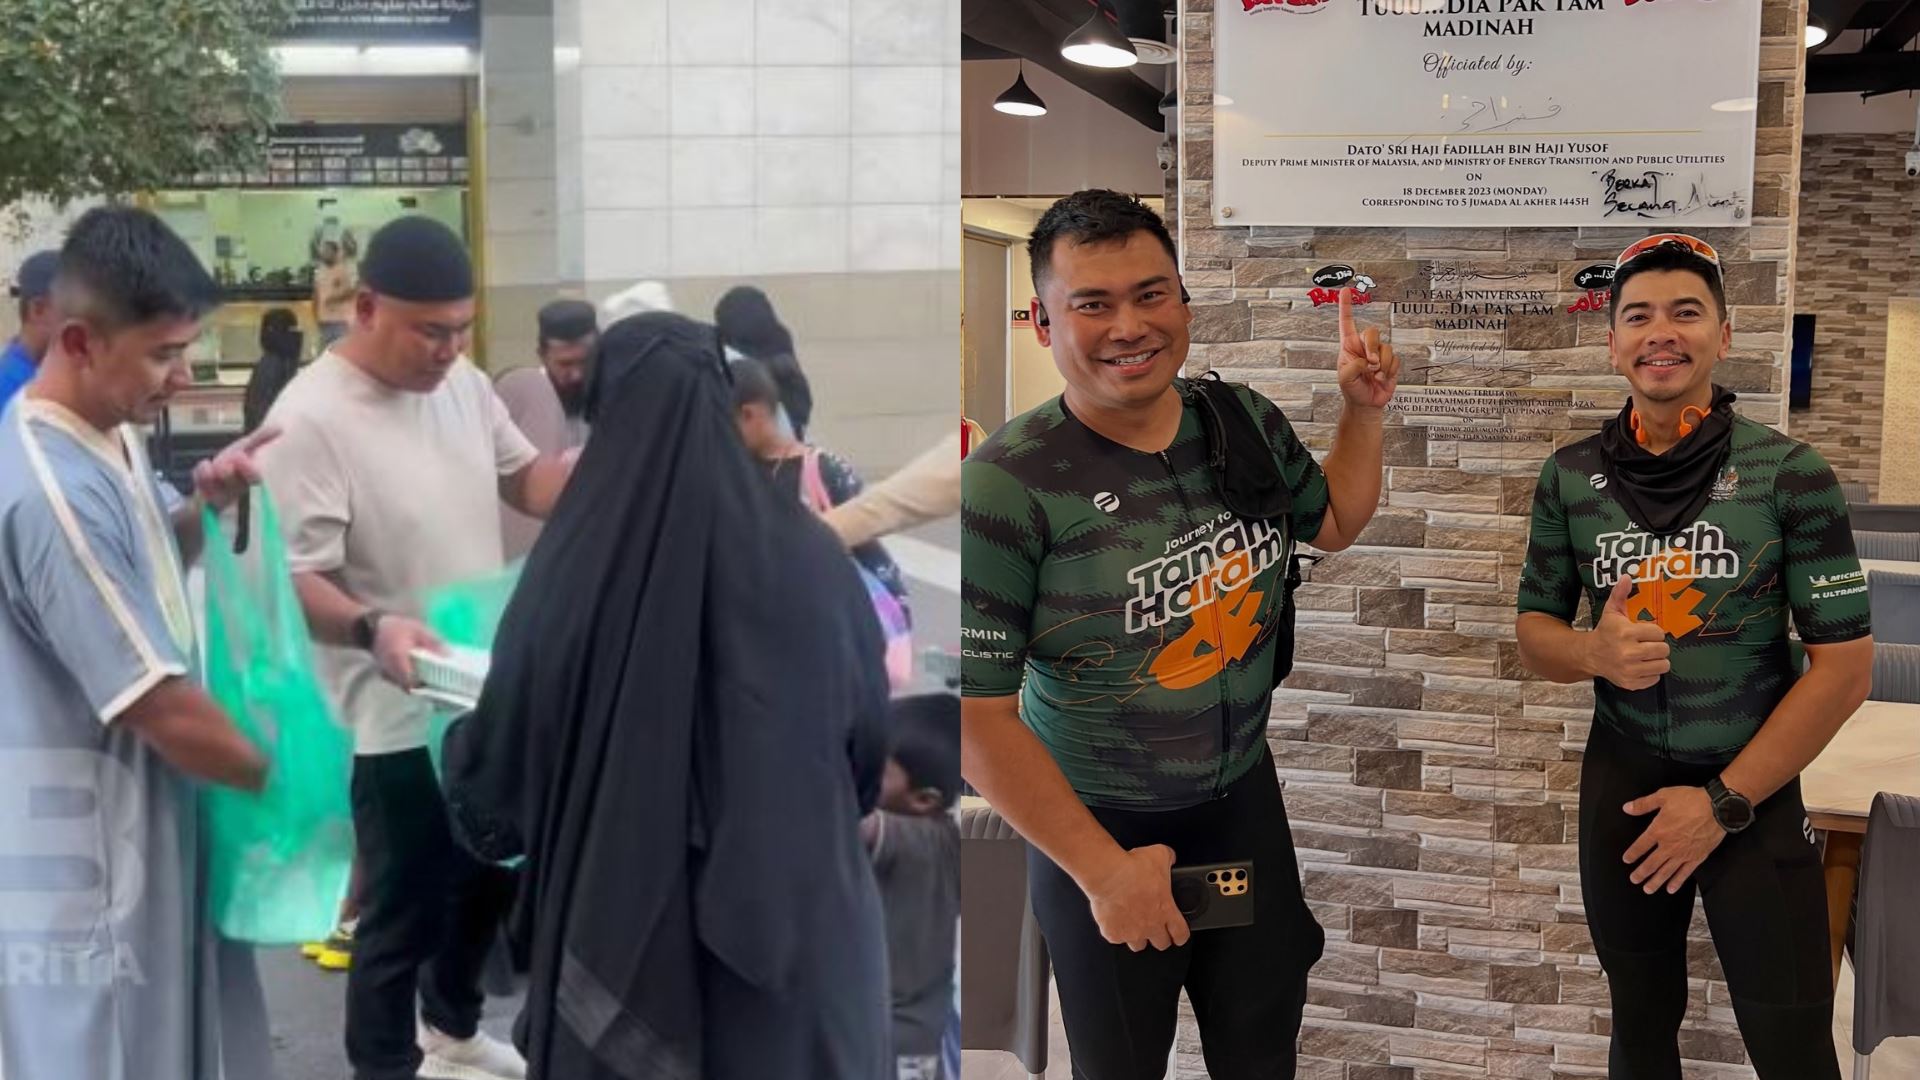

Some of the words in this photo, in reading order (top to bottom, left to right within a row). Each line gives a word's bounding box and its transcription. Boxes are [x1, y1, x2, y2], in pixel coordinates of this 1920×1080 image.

[1423, 18, 1534, 37] MADINAH
[1423, 52, 1501, 78] Officiated
[1506, 54, 1529, 77] by:
[1388, 144, 1408, 155] SRI
[1411, 144, 1439, 157] HAJI
[1443, 143, 1504, 155] FADILLAH
[1509, 143, 1531, 154] BIN
[1535, 142, 1564, 155] HAJI
[1566, 142, 1609, 153] YUSOF
[1242, 158, 1277, 167] DEPUTY
[1280, 158, 1308, 167] PRIME
[1310, 158, 1355, 167] MINISTER
[1357, 158, 1370, 167] OF
[1371, 158, 1419, 168] MALAYSIA,
[1421, 158, 1442, 166] AND
[1444, 157, 1491, 166] MINISTRY
[1493, 157, 1507, 166] OF
[1508, 156, 1546, 166] ENERGY
[1549, 156, 1608, 165] TRANSITION
[1611, 156, 1634, 164] AND
[1636, 155, 1673, 164] PUBLIC
[1676, 155, 1725, 164] UTILITIES
[1466, 173, 1482, 181] ON
[1402, 187, 1413, 196] 18
[1415, 187, 1466, 196] DECEMBER
[1468, 187, 1491, 196] 2023
[1493, 186, 1547, 196] (MONDAY)
[1362, 198, 1444, 207] CORRESPONDING
[1445, 198, 1459, 207] TO
[1461, 198, 1467, 207] 5
[1468, 198, 1507, 208] JUMADA
[1509, 198, 1522, 206] AL
[1524, 197, 1558, 206] AKHER
[1559, 197, 1590, 206] 1445H
[1421, 290, 1453, 299] YEAR
[1456, 290, 1546, 300] ANNIVERSARY
[1484, 302, 1514, 315] PAK
[1522, 303, 1554, 316] TAM
[1434, 318, 1507, 330] MADINAH
[1424, 388, 1446, 396] TUAN
[1446, 389, 1471, 397] YANG
[1387, 404, 1410, 412] YANG
[1520, 408, 1554, 416] PINANG
[1218, 510, 1232, 522] to
[1593, 549, 1740, 588] Haram
[1125, 528, 1283, 634] Haram
[961, 627, 1007, 641] RMIN
[961, 648, 1014, 659] CLISTIC
